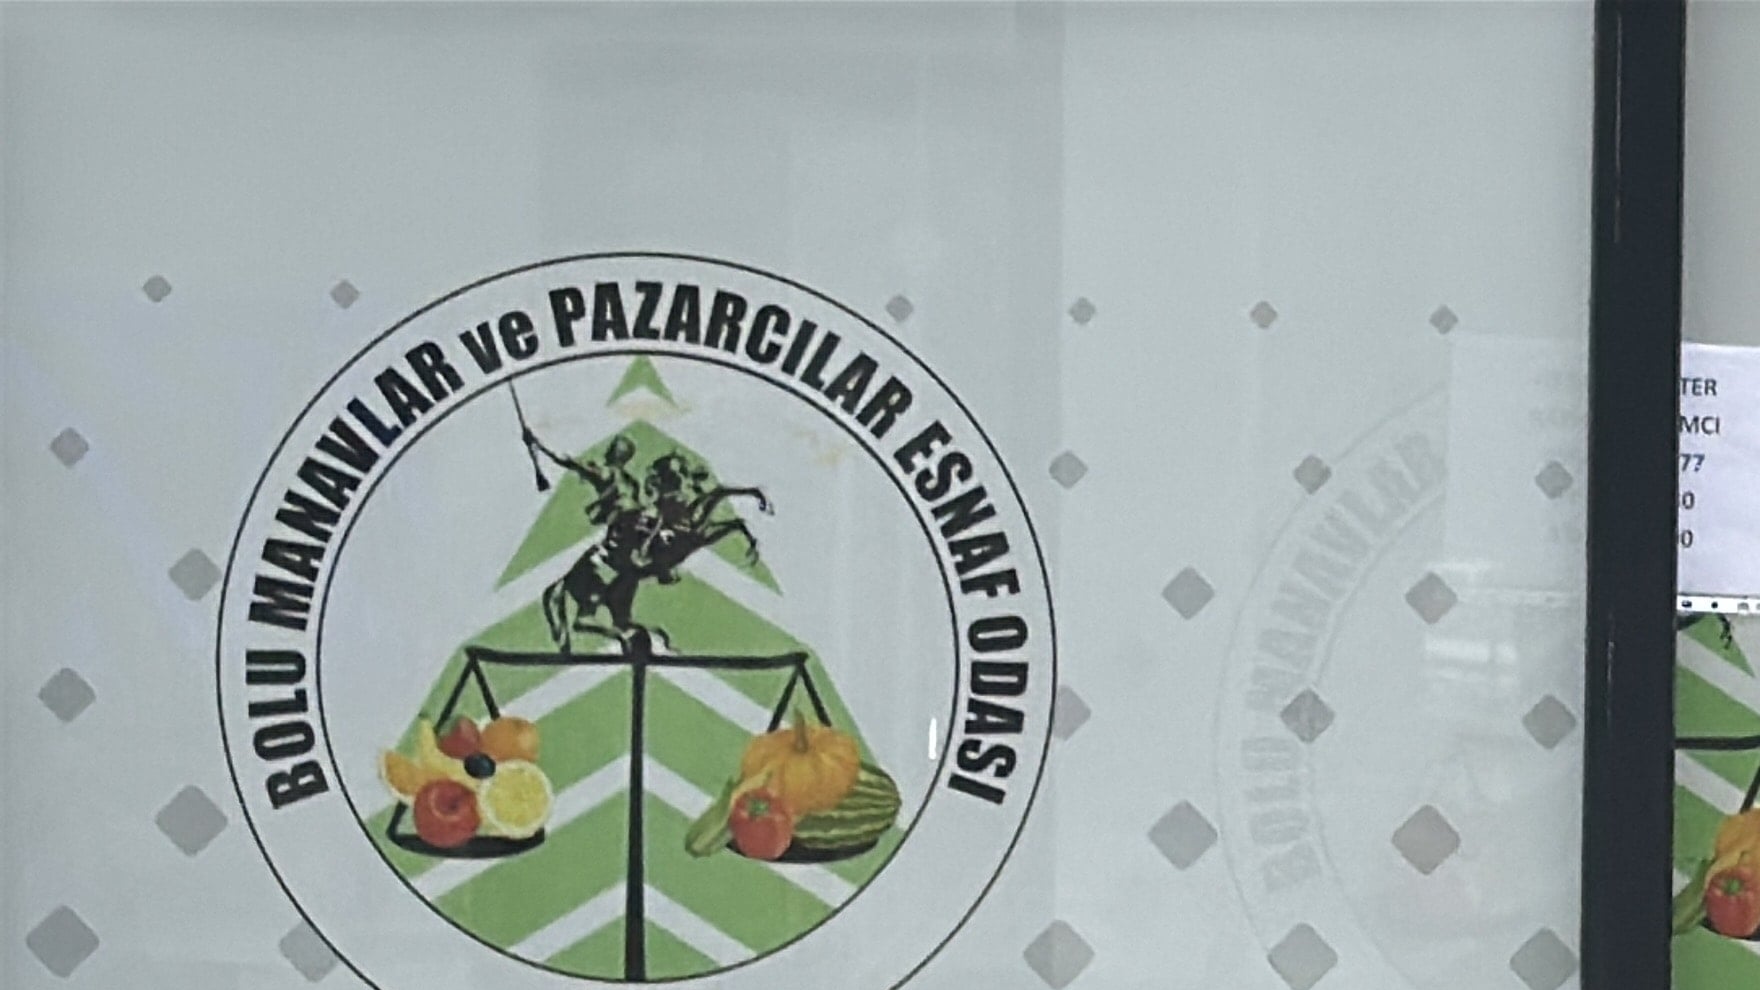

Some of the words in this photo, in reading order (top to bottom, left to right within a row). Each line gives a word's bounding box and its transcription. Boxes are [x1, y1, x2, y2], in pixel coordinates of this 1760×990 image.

[460, 309, 539, 376] ve
[549, 280, 914, 438] PAZARCILAR
[249, 340, 466, 632] MANAVLAR
[893, 420, 1021, 600] ESNAF
[245, 649, 330, 809] BOLU
[947, 615, 1030, 805] ODASI
